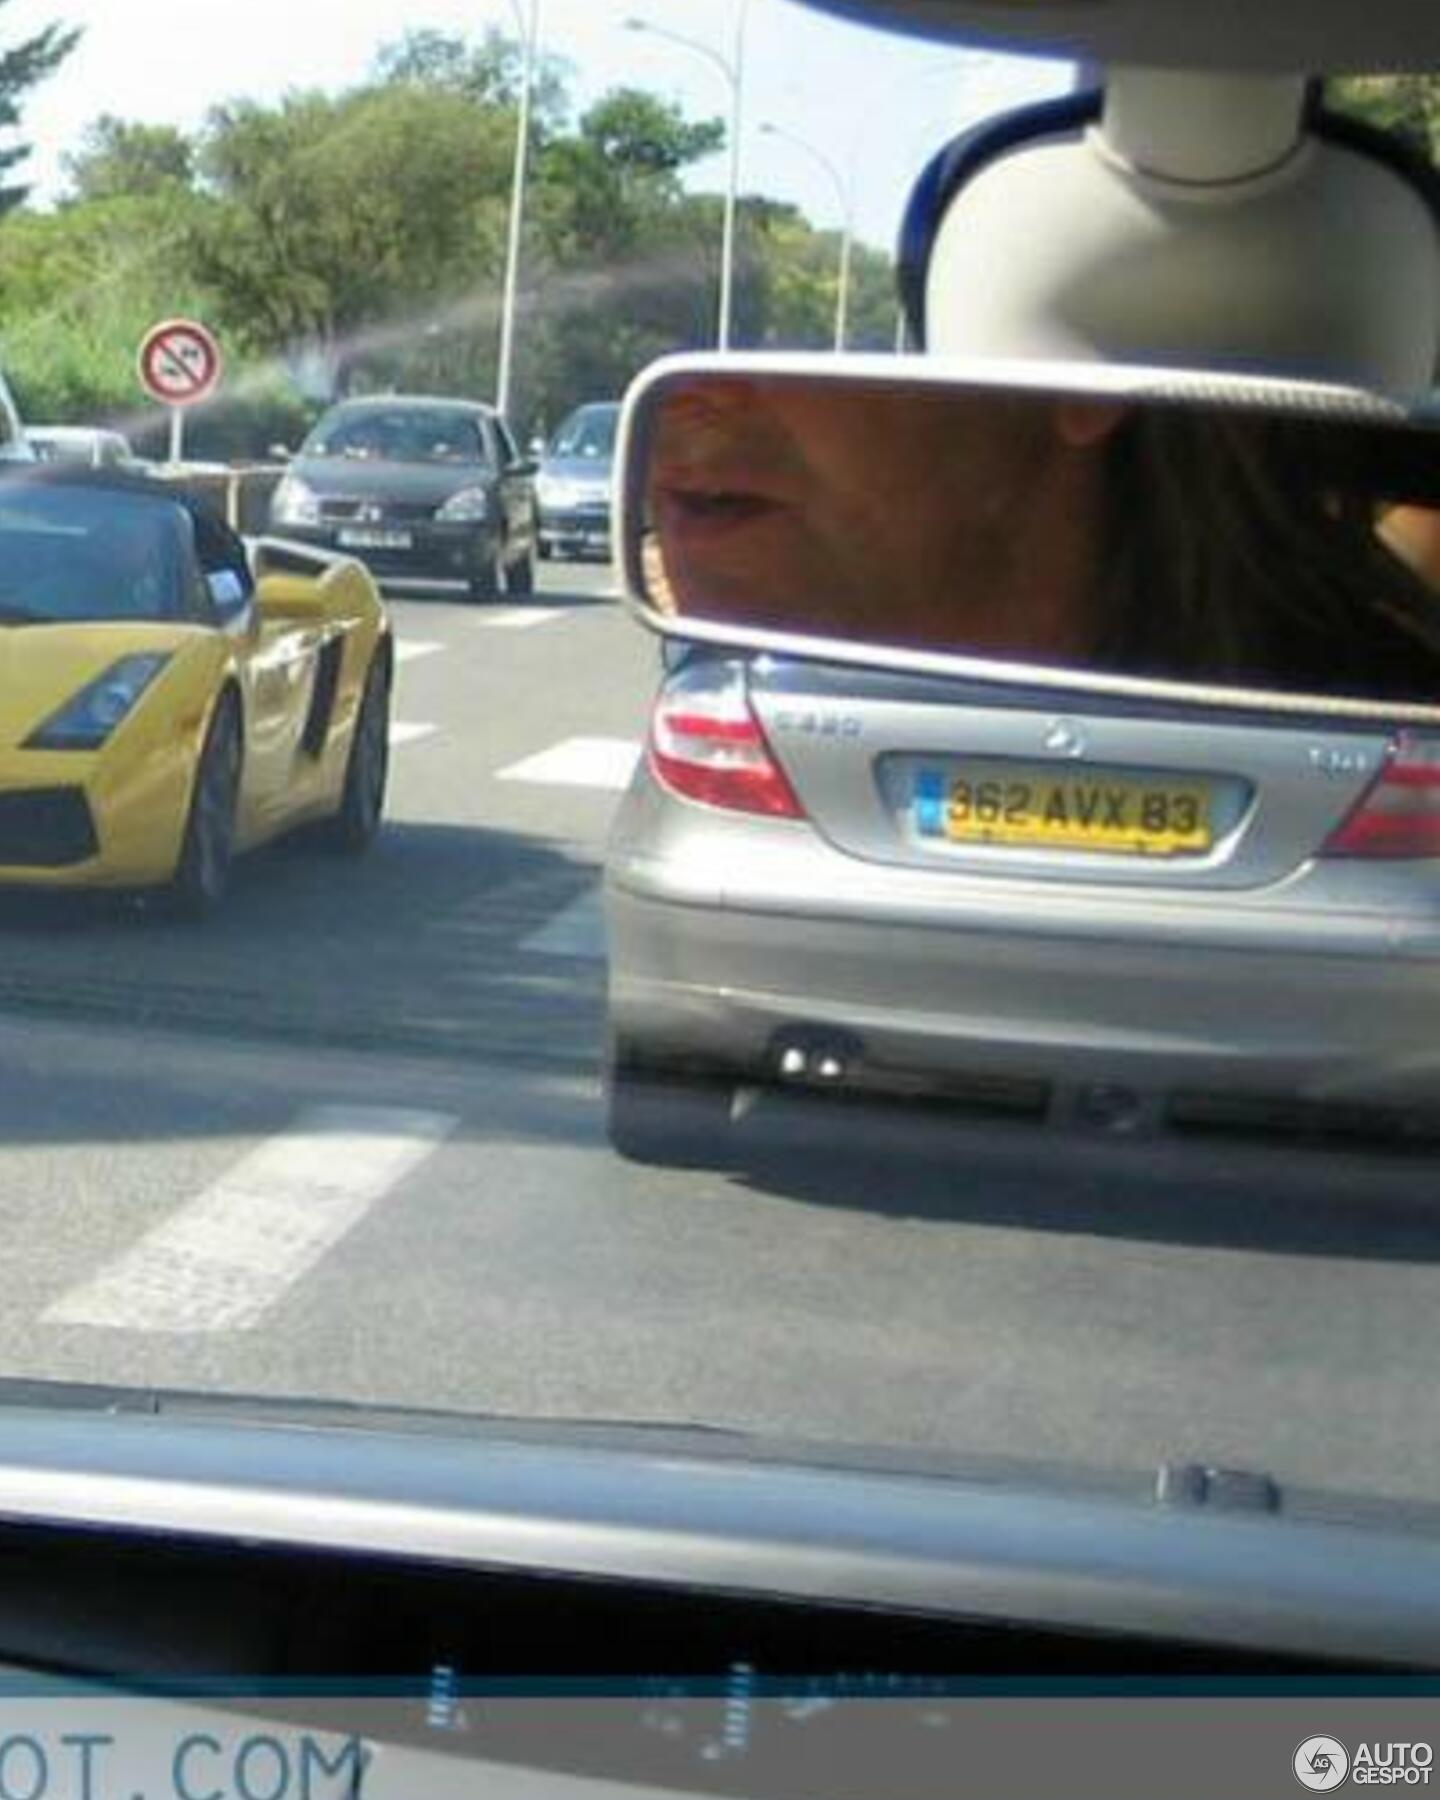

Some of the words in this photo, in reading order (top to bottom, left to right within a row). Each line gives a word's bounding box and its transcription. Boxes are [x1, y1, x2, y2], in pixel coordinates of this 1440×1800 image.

[949, 776, 1032, 826] 362
[1043, 785, 1128, 831] AVX
[1141, 791, 1200, 836] 83
